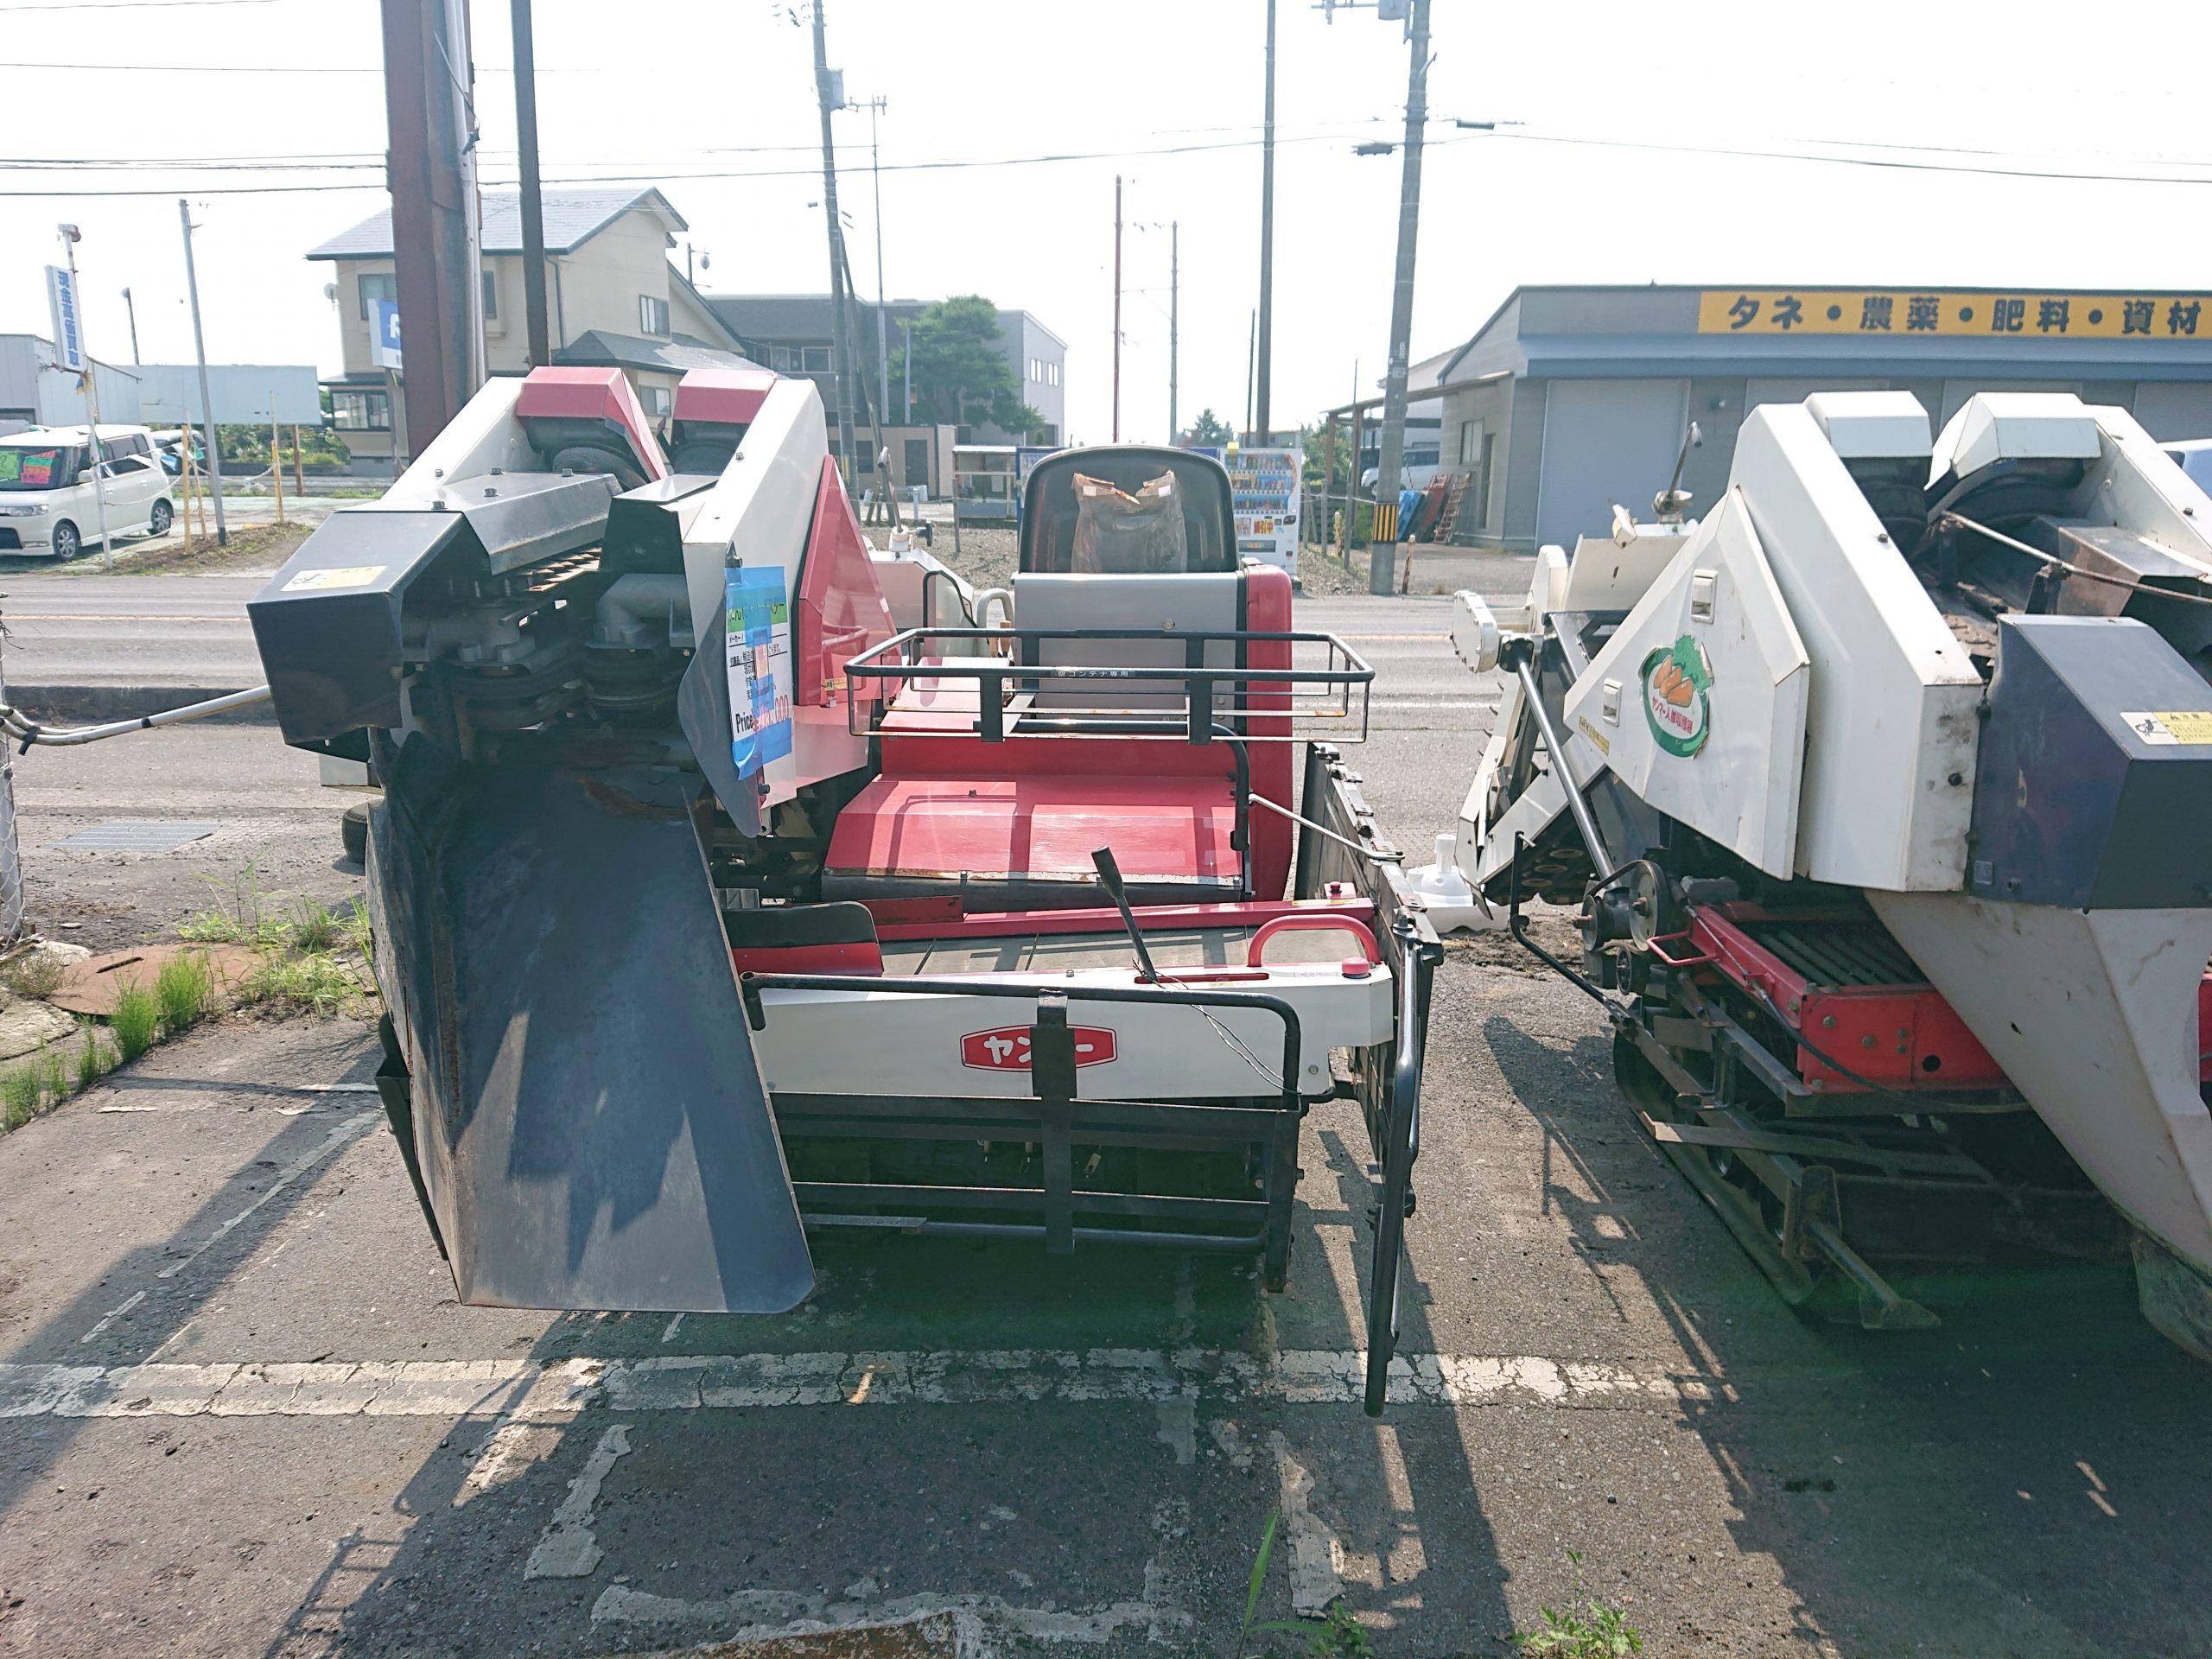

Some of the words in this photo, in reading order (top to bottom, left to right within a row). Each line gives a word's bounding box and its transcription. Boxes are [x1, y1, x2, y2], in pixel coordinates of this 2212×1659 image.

[1728, 295, 2202, 334] タネ・農薬・肥料・資材
[735, 712, 753, 733] Price
[983, 1035, 1094, 1065] ヤンー
